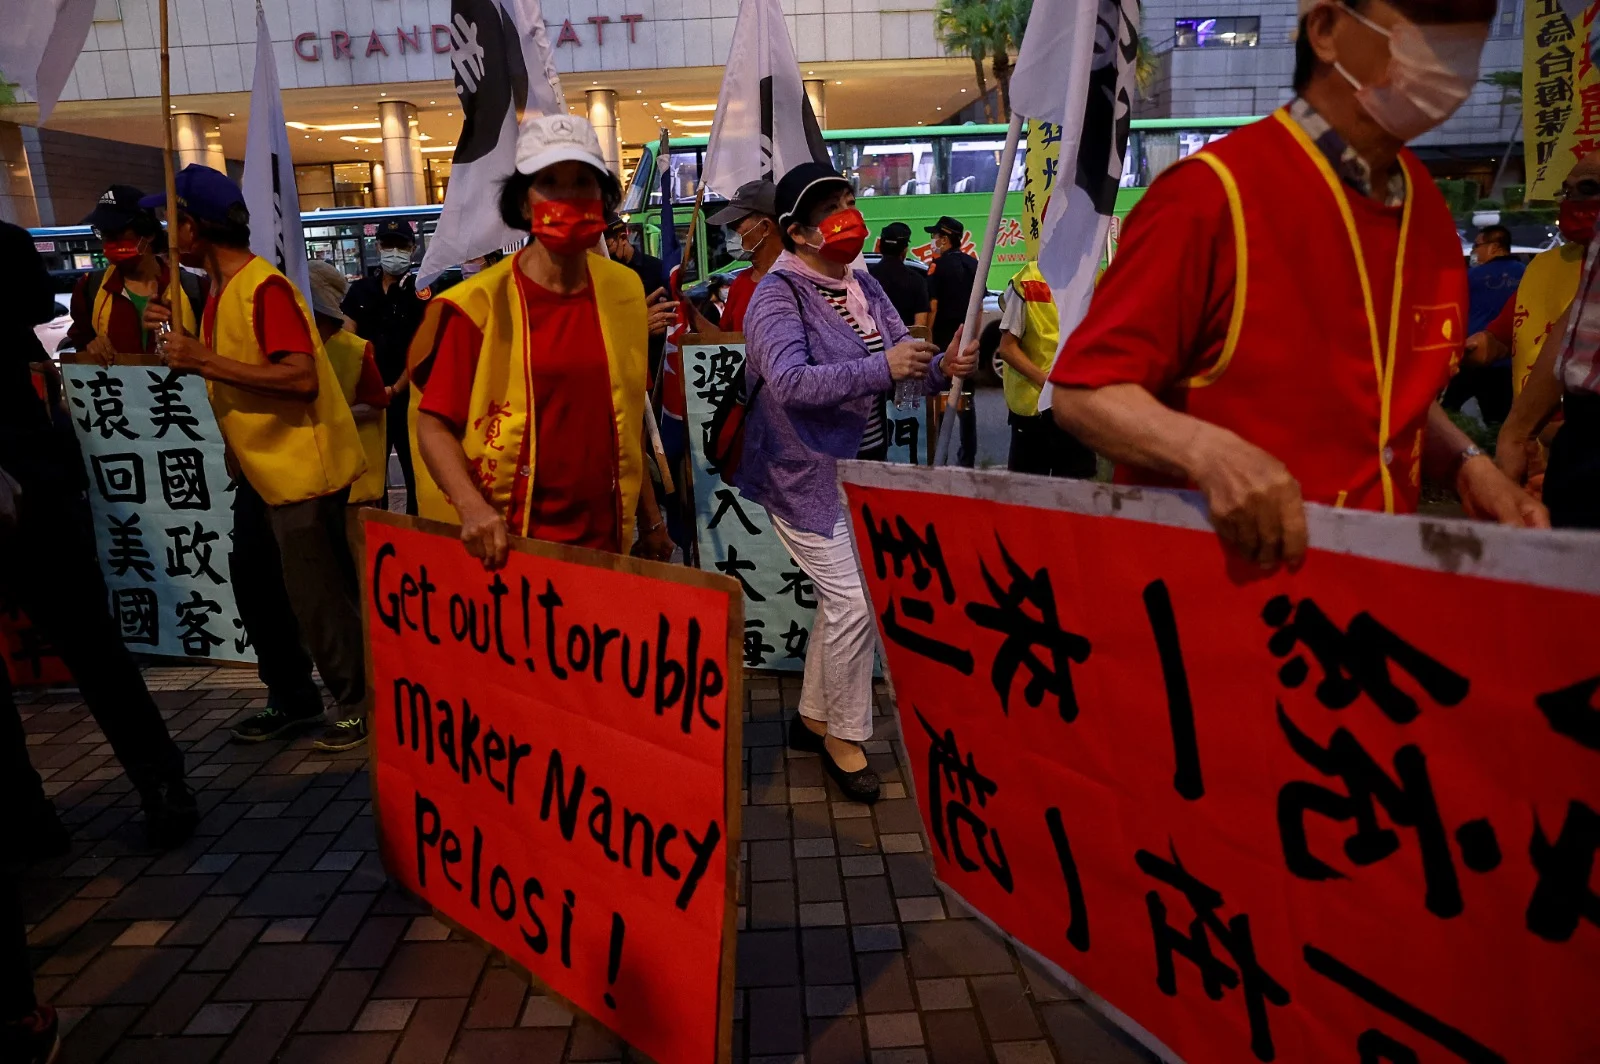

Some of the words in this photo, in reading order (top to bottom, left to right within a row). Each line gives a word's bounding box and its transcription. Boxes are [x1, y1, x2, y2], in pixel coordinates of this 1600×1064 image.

[294, 24, 452, 62] GRAND
[544, 14, 643, 48] ATT
[70, 371, 160, 647] 滾回美國
[146, 369, 229, 657] 美國政客
[373, 541, 440, 635] Get
[537, 578, 723, 733] toruble
[393, 676, 532, 804] maker
[539, 748, 721, 910] Nancy
